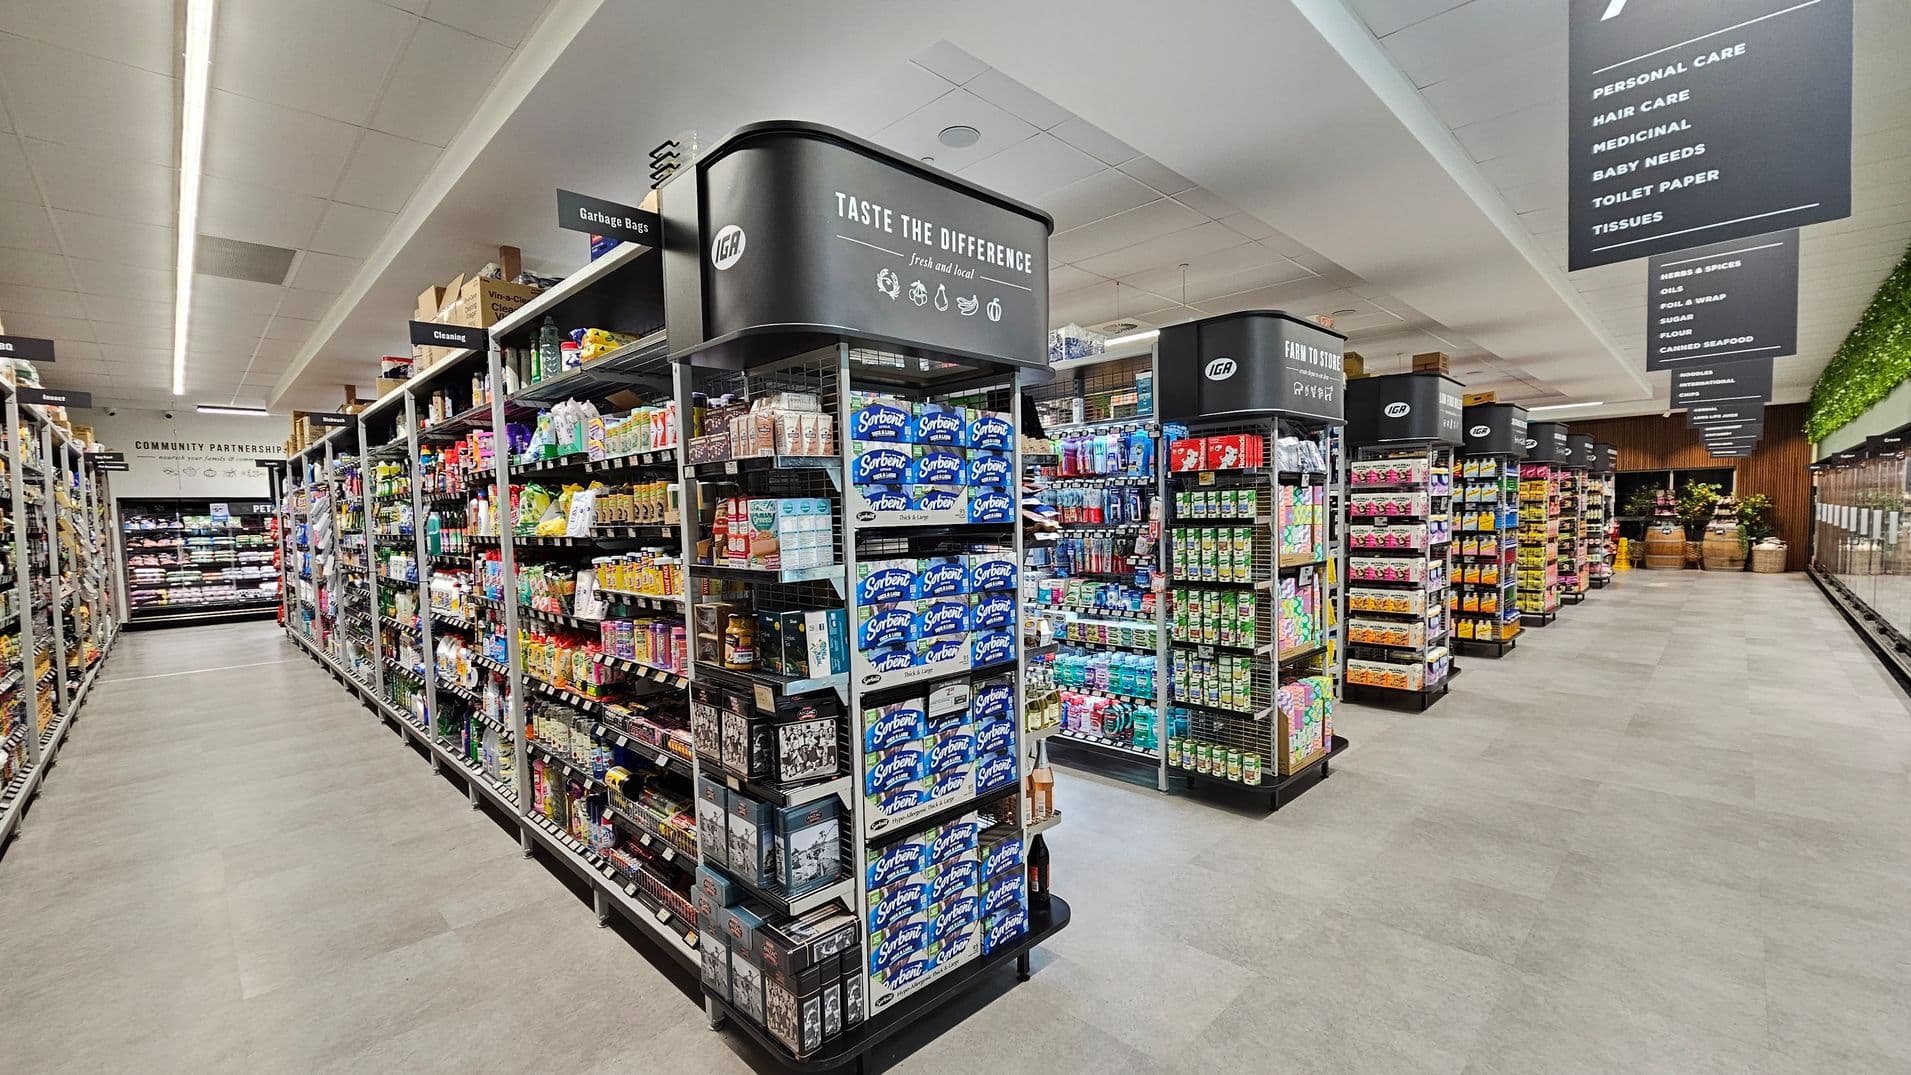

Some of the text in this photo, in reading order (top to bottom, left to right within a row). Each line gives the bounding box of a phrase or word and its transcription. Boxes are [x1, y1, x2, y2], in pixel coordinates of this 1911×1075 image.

[1592, 43, 1746, 100] PERSONAL CARE
[1592, 89, 1690, 127] HAIR CARE
[1592, 119, 1691, 154] MEDICINAL
[1592, 144, 1705, 181] BABY NEEDS
[1592, 169, 1720, 208] TOILET PAPER
[579, 208, 649, 233] Garbage Bags
[835, 192, 1032, 274] TASTE THE DIFFERENCE
[1592, 212, 1664, 235] TISSUES
[715, 230, 741, 264] IGA
[909, 253, 975, 280] fresh and local
[1660, 269, 1693, 280] HERBS
[1705, 260, 1742, 272] SPICES
[1660, 286, 1684, 295] OILS
[1660, 301, 1683, 310] FOIL
[1695, 293, 1726, 304] WRAP
[1660, 314, 1694, 324] SUGAR
[0, 342, 14, 351] BQ
[434, 330, 466, 342] Cleaning
[1660, 329, 1692, 338] FLOUR
[1660, 336, 1754, 353] CANNED SEAFOOD
[1208, 362, 1233, 376] IGA
[1285, 341, 1340, 371] FARM TO STORE
[859, 409, 905, 432] Sorbent
[1387, 405, 1406, 414] IGA
[919, 415, 960, 437] Sorbent
[972, 420, 1008, 441] Sorbent
[135, 441, 204, 451] COMMUNITY
[860, 452, 905, 476] Sorbent
[919, 455, 960, 477] Sorbent
[972, 457, 1007, 479] Sorbent
[920, 495, 955, 510] Sorben
[974, 495, 1009, 517] Sorbent
[865, 573, 910, 598] Sorbent
[924, 566, 963, 592] Sorbent
[974, 563, 1011, 587] Sorbent
[924, 606, 963, 631] Sorbent
[976, 598, 1010, 623] Sorbent
[867, 614, 911, 640] Sorbent
[926, 645, 960, 663] Sorben
[975, 634, 1010, 660] Sorbent
[976, 686, 1009, 714] Sorbent
[874, 713, 917, 744] Sorbent
[977, 722, 1010, 750] Sorbent
[931, 736, 968, 768] Sorbent
[873, 752, 917, 786] Sorbent
[978, 758, 1011, 787] Sorbent
[932, 775, 963, 798] Sorben
[932, 826, 973, 859] Sorbent
[875, 848, 920, 882] Sorbent
[987, 842, 1020, 875] Sorbent
[933, 863, 973, 897] Sorbent
[877, 886, 921, 924] Sorbent
[986, 877, 1021, 910] Sorbent
[935, 899, 973, 935] Sorbent
[990, 912, 1023, 947] Sorbent
[878, 925, 922, 964] Sorbent
[936, 936, 969, 965] Sorben
